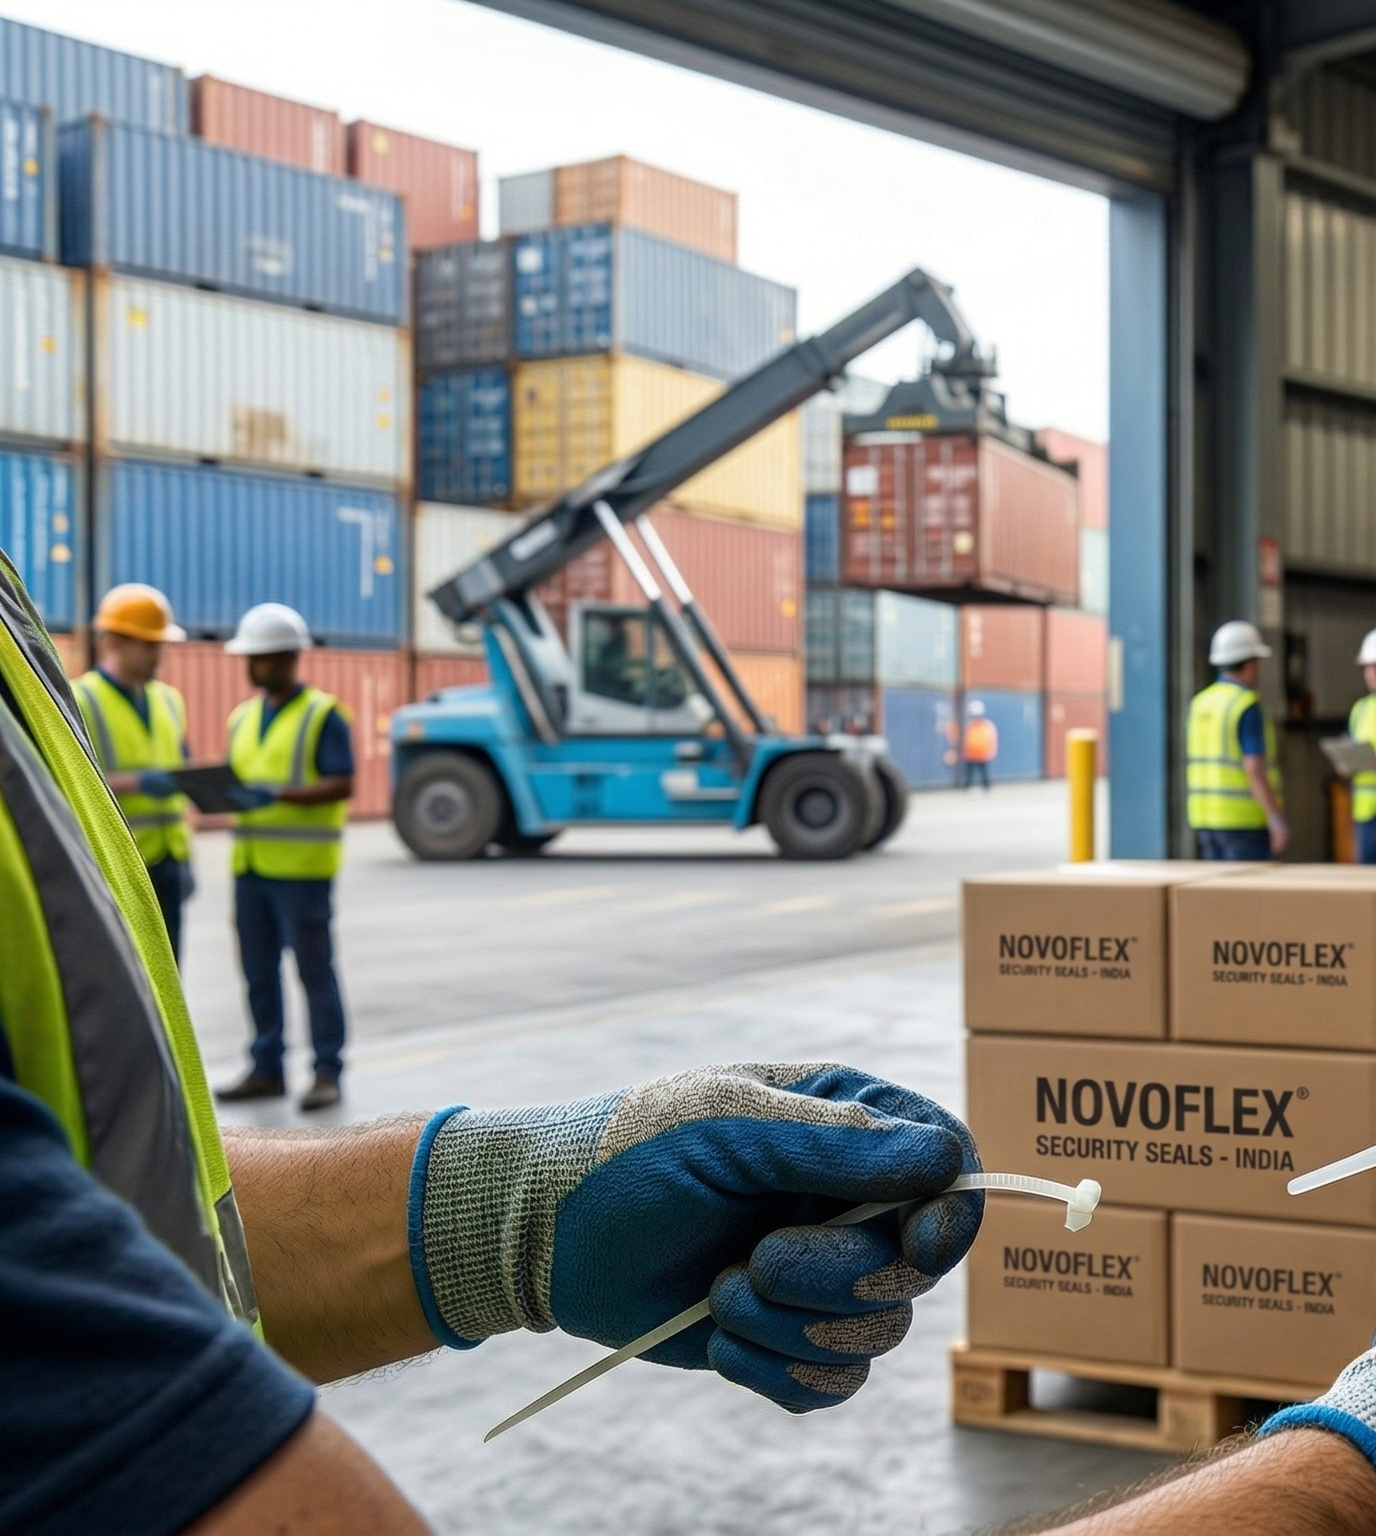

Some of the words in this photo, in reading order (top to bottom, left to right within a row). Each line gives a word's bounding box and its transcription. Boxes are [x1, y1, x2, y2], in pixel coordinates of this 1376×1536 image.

[999, 963, 1052, 976] SECURITY
[1054, 965, 1088, 979] SEALS
[1101, 967, 1131, 979] INDIA
[1213, 970, 1267, 983] SECURITY
[1270, 972, 1305, 985] SEALS
[1317, 974, 1348, 987] INDIA
[1036, 1135, 1139, 1161] SECURITY
[1145, 1142, 1213, 1166] SEALS
[1236, 1148, 1295, 1171] INDIA
[1003, 1276, 1055, 1291] SECURITY
[1058, 1281, 1092, 1294] SEALS
[1103, 1284, 1133, 1298] INDIA
[1202, 1293, 1256, 1309] SECURITY
[1258, 1298, 1294, 1312] SEALS
[1305, 1301, 1335, 1315] INDIA
